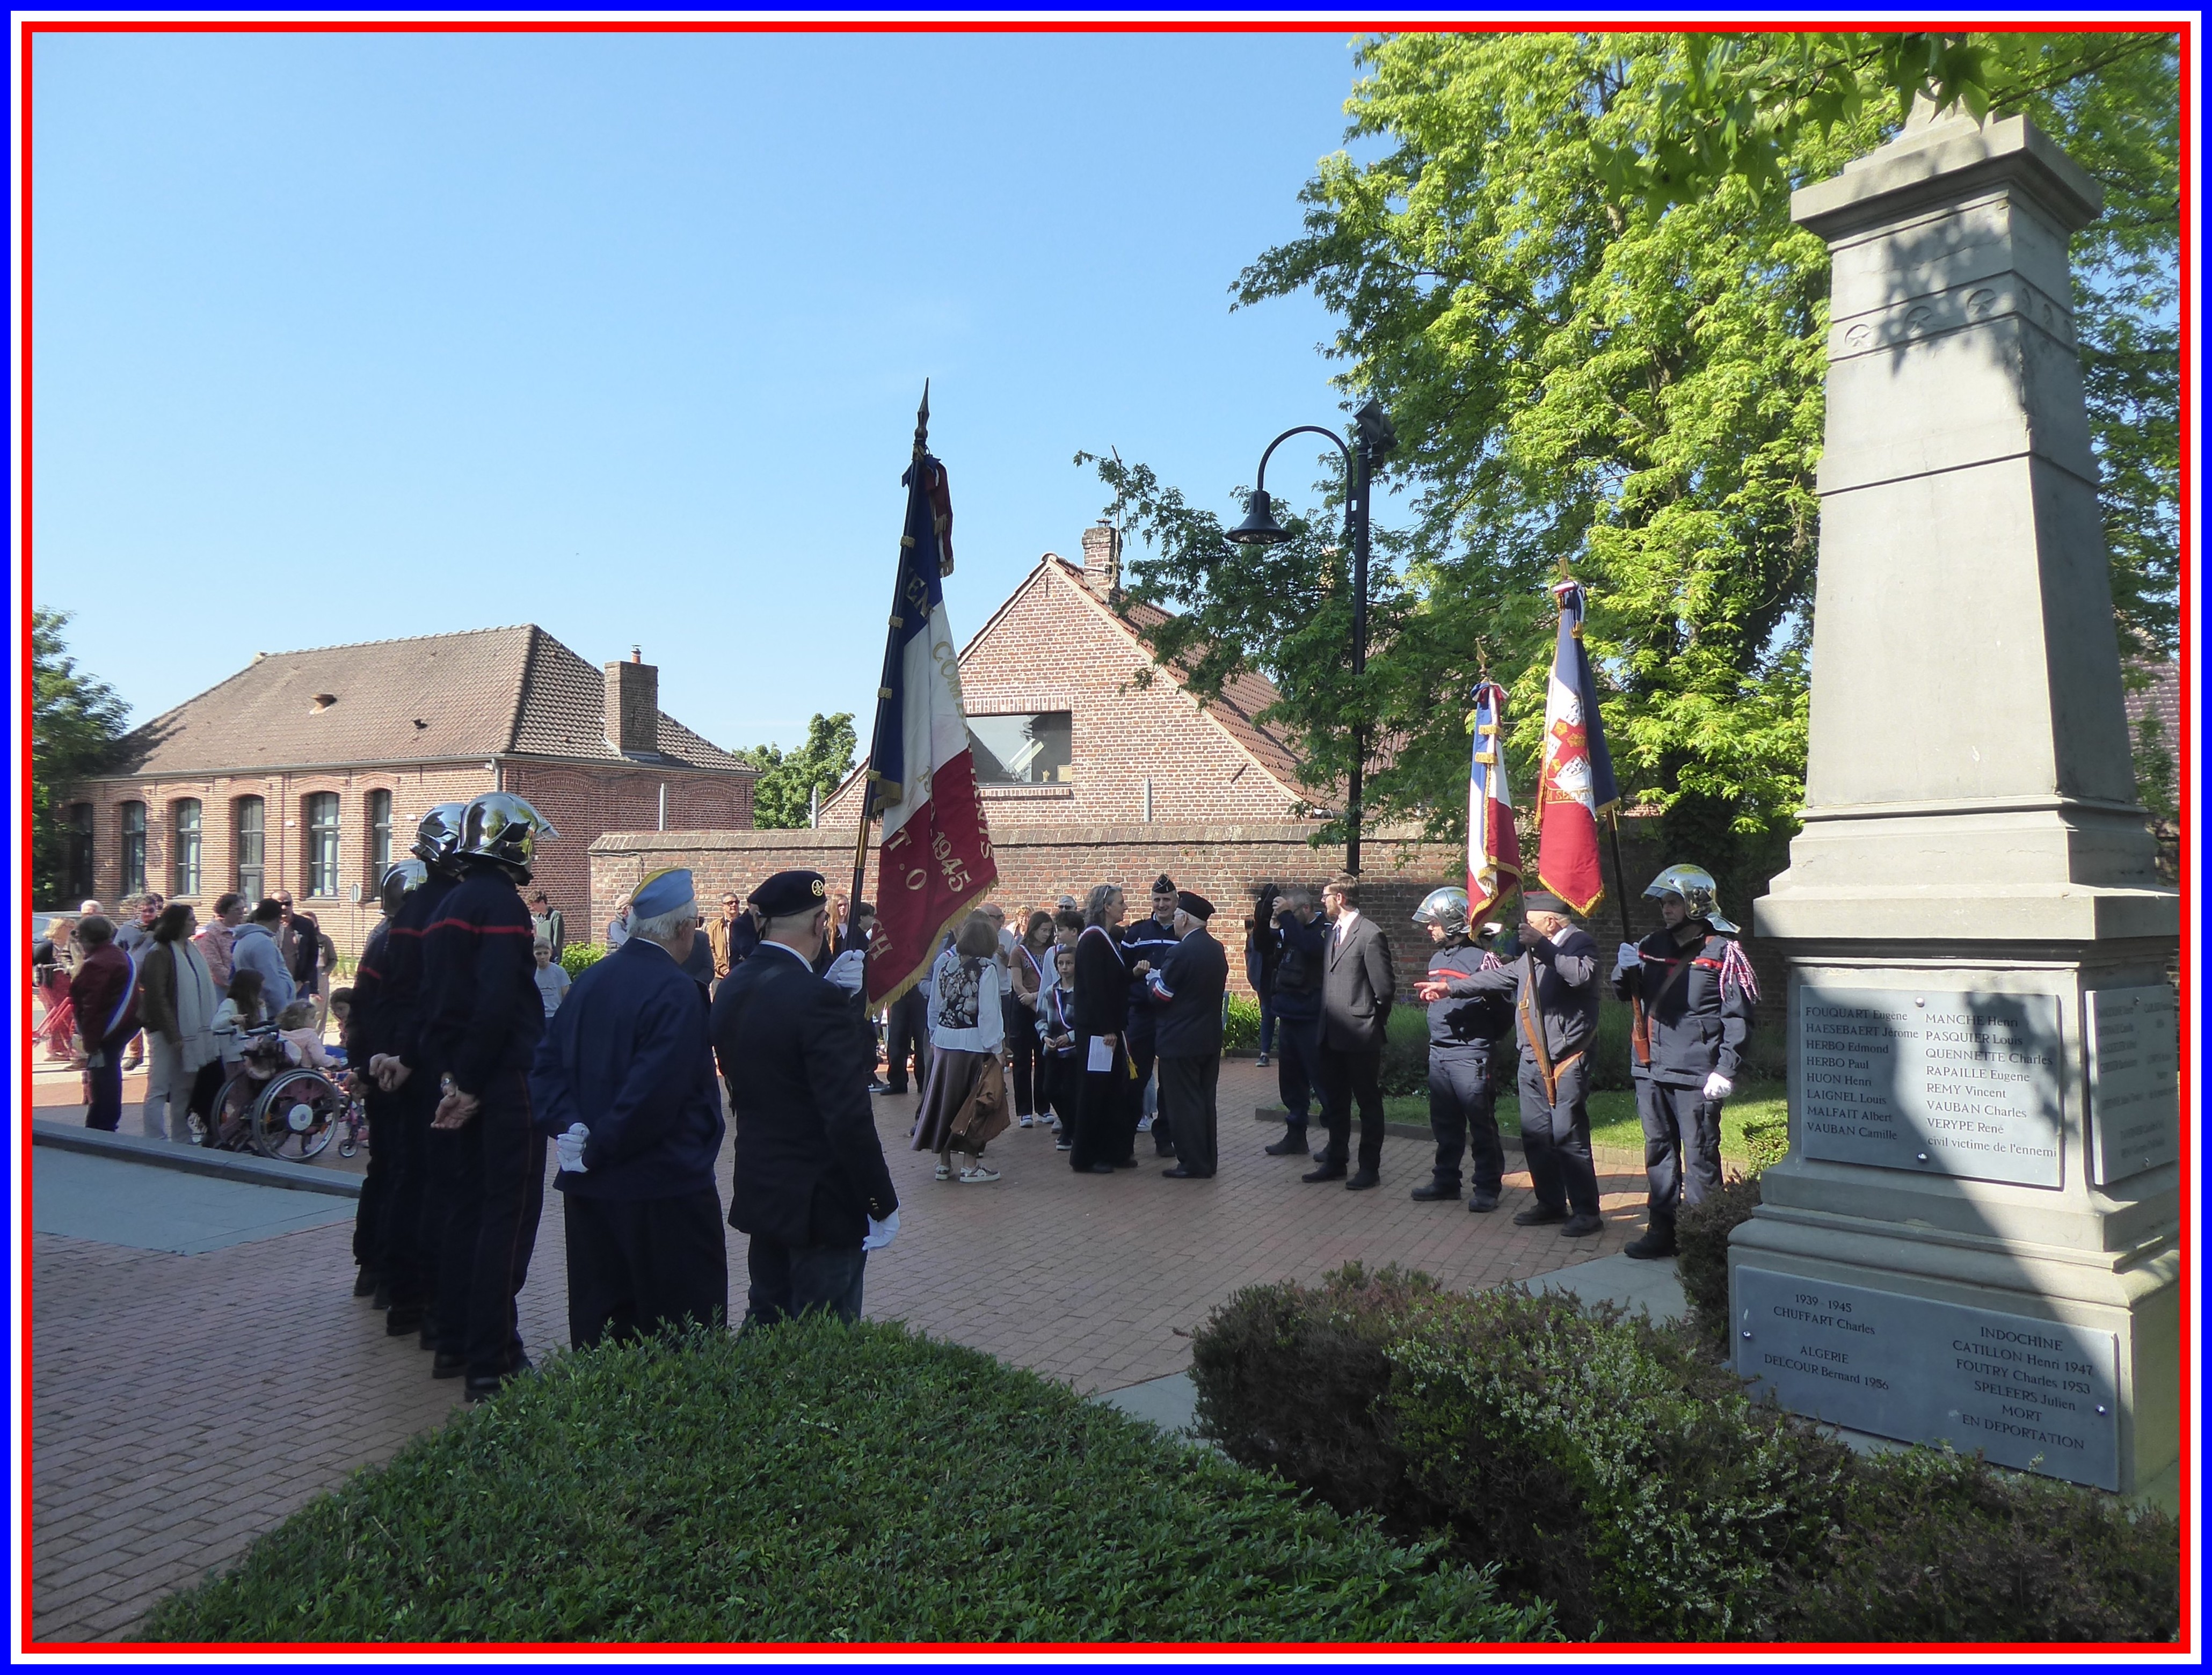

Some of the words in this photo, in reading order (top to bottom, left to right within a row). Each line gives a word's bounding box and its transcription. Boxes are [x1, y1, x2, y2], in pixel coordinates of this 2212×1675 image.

[932, 831, 972, 893] 1945
[1806, 1007, 1869, 1019] FOUQUART
[1873, 1010, 1908, 1021] Eugène
[1925, 1014, 1985, 1025] MANCHE
[1988, 1016, 2018, 1028] Henri
[1806, 1023, 1879, 1037] HAESEBAERT
[1882, 1026, 1919, 1038] Jérôme
[1926, 1031, 1990, 1044] PASQUIER
[1992, 1033, 2023, 1046] Louis
[1806, 1040, 1845, 1052] HERBO
[1848, 1042, 1889, 1054] Edmond
[1806, 1056, 1845, 1068] HERBO
[1848, 1058, 1869, 1069] Paul
[1925, 1048, 2006, 1062] QUENNETTE
[2009, 1052, 2054, 1065] Charles
[1806, 1073, 1842, 1084] HUON
[1845, 1075, 1872, 1087] Henri
[1926, 1066, 1987, 1079] RAPAILLE
[1807, 1089, 1857, 1102] LAIGNEL
[1860, 1093, 1887, 1105] Louis
[1926, 1083, 1961, 1095] REMY
[1964, 1086, 2006, 1098] Vincent
[1807, 1105, 1859, 1119] MALFAIT
[1861, 1111, 1893, 1123] Albert
[1926, 1100, 1981, 1114] VAUBAN
[1984, 1105, 2027, 1118] Charles
[1807, 1122, 1856, 1136] VAUBAN
[1858, 1127, 1898, 1140] Camille
[1927, 1117, 1974, 1132] VERYPE
[1977, 1122, 2005, 1134] René
[1927, 1137, 1948, 1147] civil
[1951, 1139, 1991, 1151] victime
[1993, 1142, 2006, 1153] de
[2010, 1143, 2057, 1157] l'ennemi
[1795, 1294, 1819, 1306] 1939
[1828, 1300, 1852, 1313] 1945
[1773, 1306, 1834, 1326] CHUFFART
[1837, 1319, 1875, 1335] Charles
[1981, 1326, 2063, 1351] INDOCHINE
[1800, 1345, 1849, 1364] ALGERIE
[1953, 1340, 2022, 1361] CATILLON
[2027, 1353, 2060, 1370] Henri
[2065, 1361, 2093, 1375] 1947
[1764, 1353, 1819, 1375] DELCOUR
[1821, 1366, 1860, 1384] Bernard
[1864, 1377, 1889, 1390] 1956
[1956, 1358, 2009, 1378] FOUTRY
[2013, 1370, 2058, 1388] Charles
[2062, 1380, 2091, 1394] 1953
[1974, 1380, 2038, 1403] SPELEERS
[2041, 1394, 2076, 1411] Julien
[2002, 1404, 2042, 1422] MORT
[1962, 1414, 1980, 1426] EN
[1984, 1419, 2085, 1450] DEPORTATION
